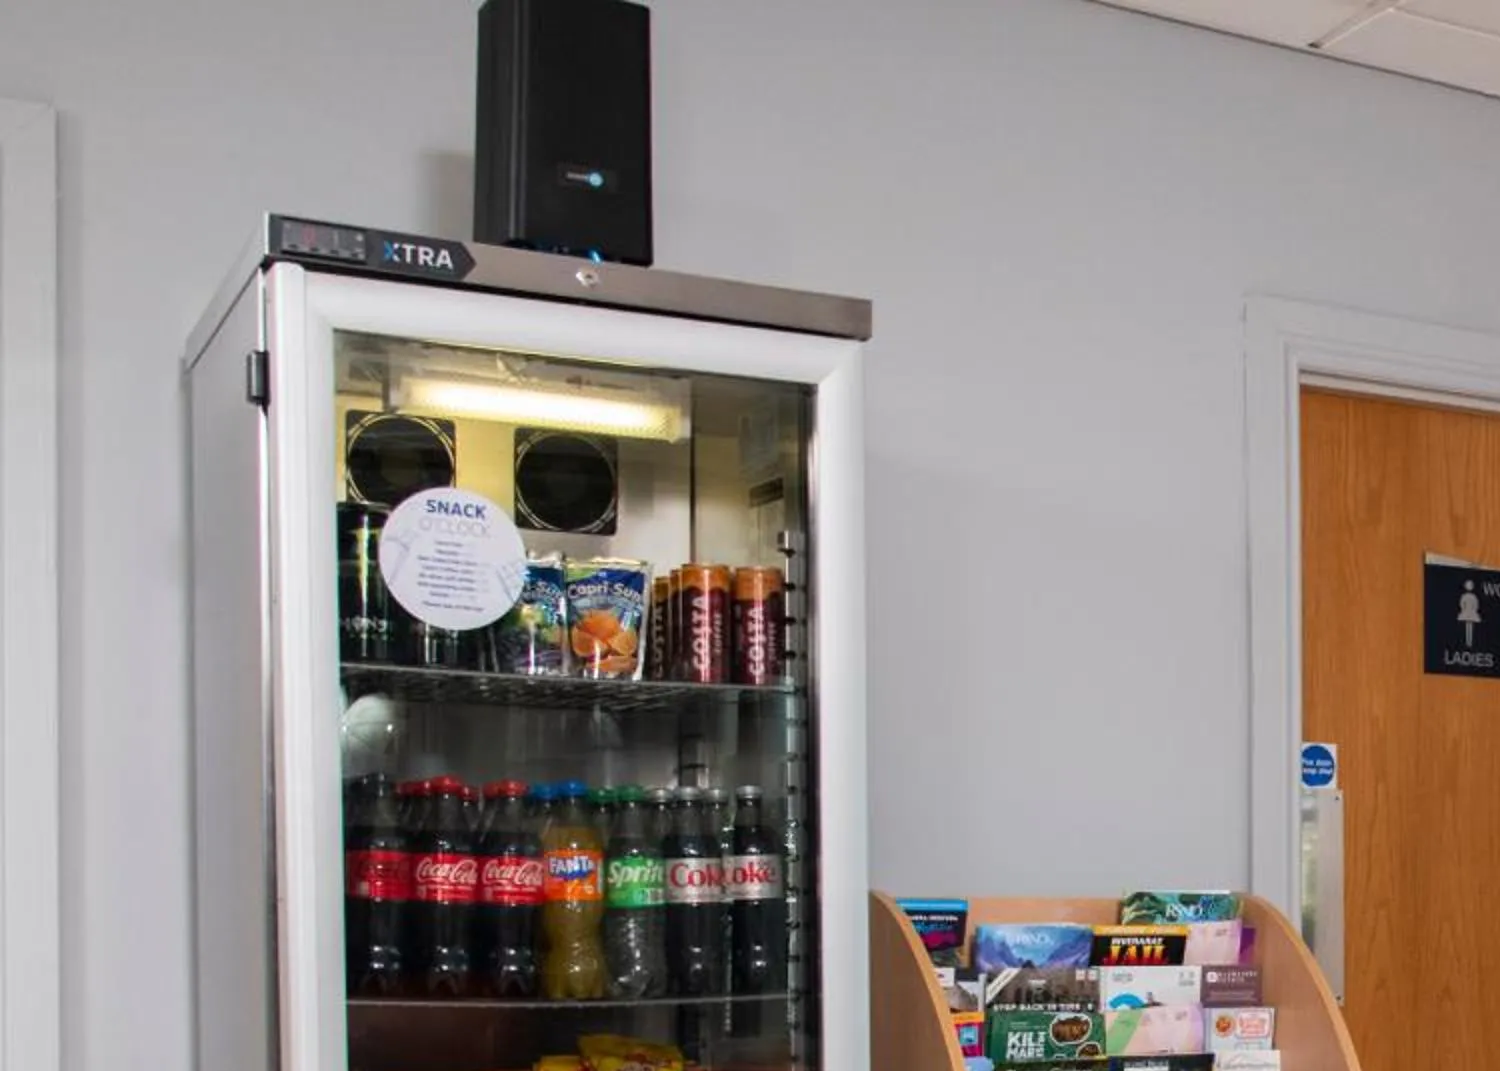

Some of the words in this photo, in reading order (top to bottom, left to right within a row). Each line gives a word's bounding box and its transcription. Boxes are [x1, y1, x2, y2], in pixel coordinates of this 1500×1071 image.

[384, 240, 453, 269] XTRA
[426, 499, 488, 519] SNACK
[692, 595, 712, 671] COSTA
[749, 606, 766, 677] COSTA
[1443, 649, 1495, 668] LADIES
[416, 857, 478, 885] Coca-Cola
[481, 858, 544, 886] Coca-Cola
